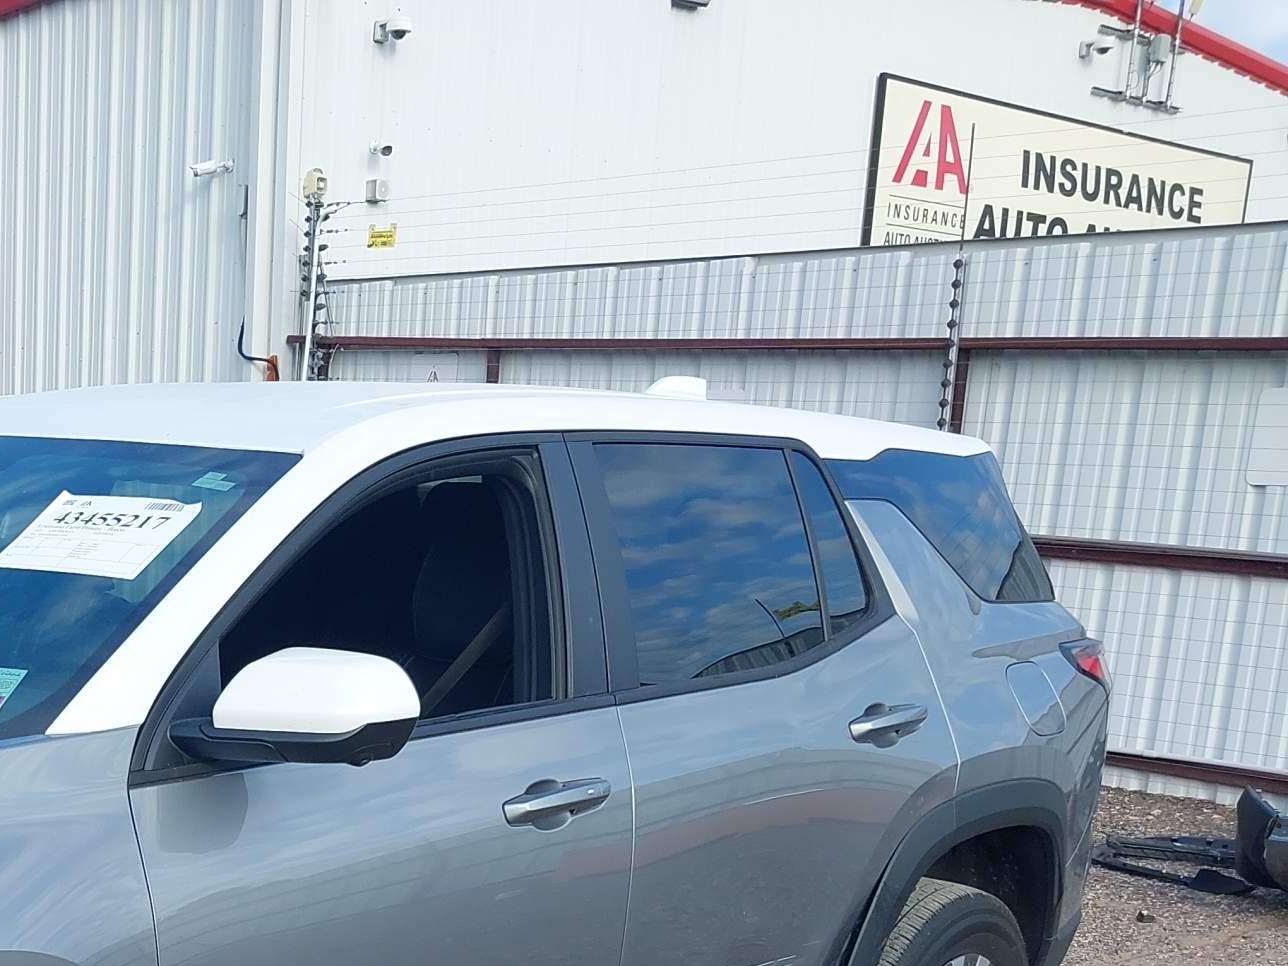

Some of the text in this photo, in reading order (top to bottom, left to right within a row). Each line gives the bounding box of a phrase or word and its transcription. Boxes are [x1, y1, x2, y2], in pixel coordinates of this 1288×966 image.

[1021, 149, 1204, 224] INSURANCE
[887, 202, 965, 229] INSURANCE
[973, 204, 1068, 238] AUTO
[53, 511, 173, 530] 43455217
